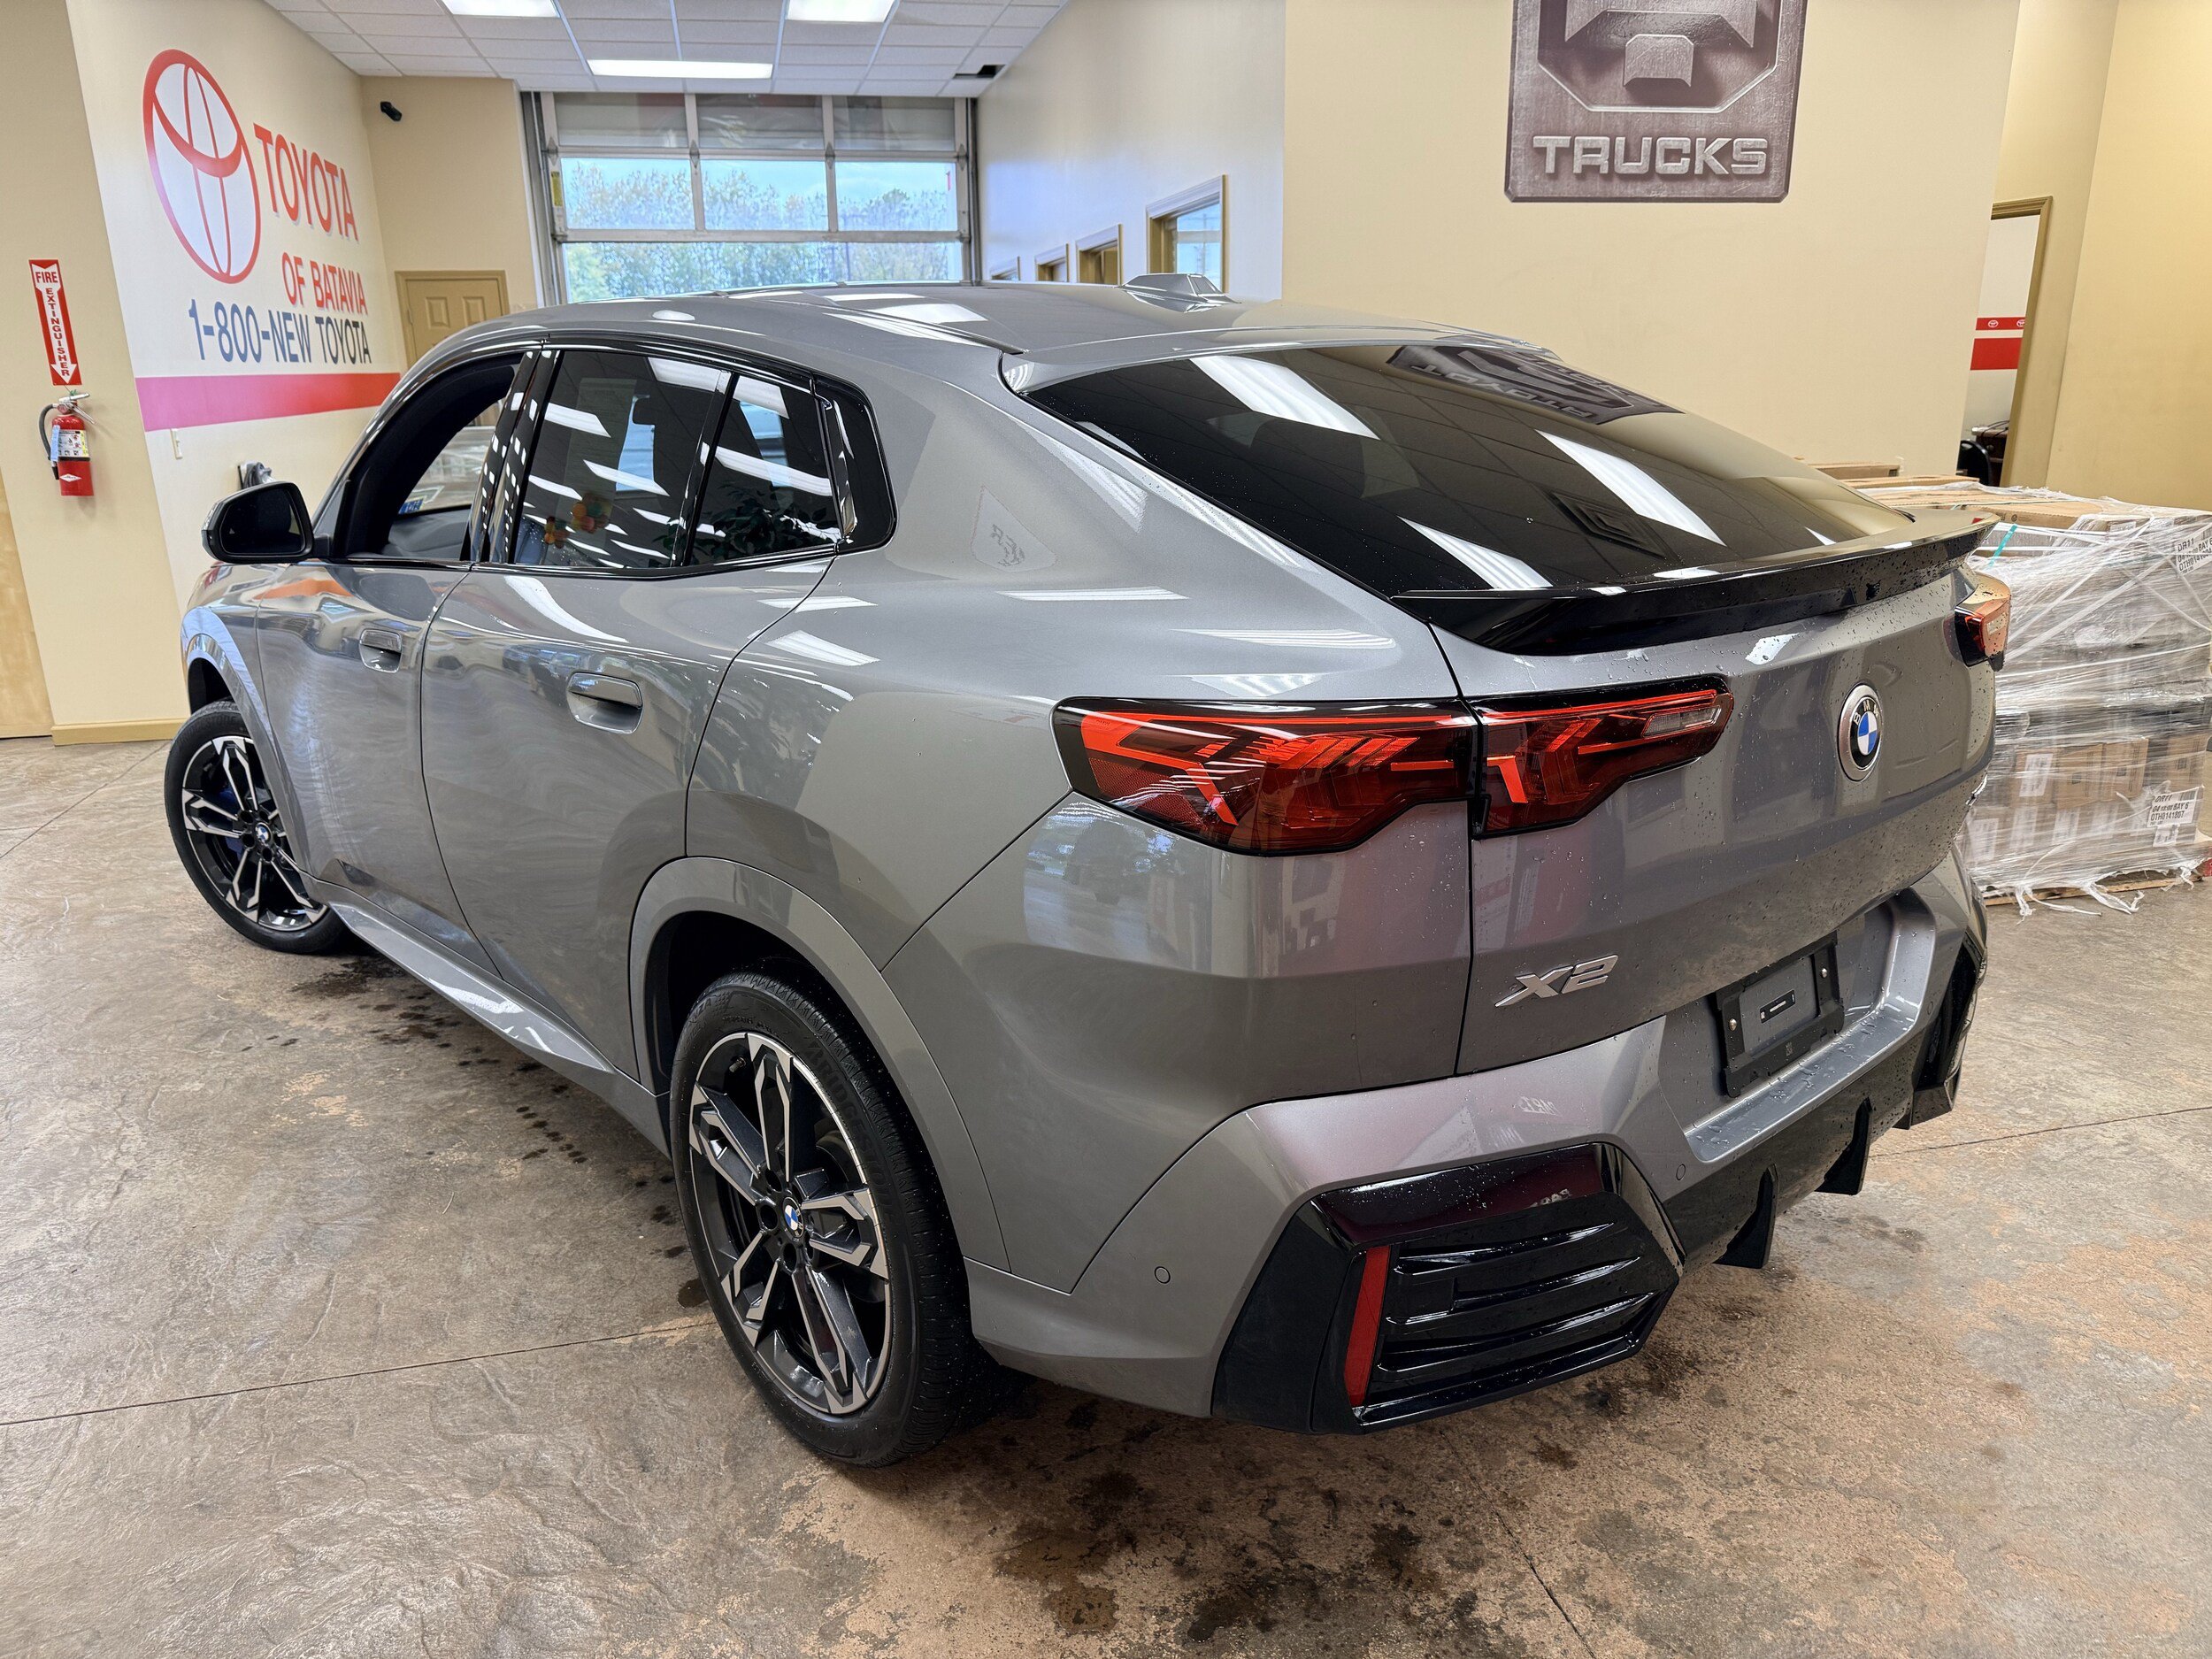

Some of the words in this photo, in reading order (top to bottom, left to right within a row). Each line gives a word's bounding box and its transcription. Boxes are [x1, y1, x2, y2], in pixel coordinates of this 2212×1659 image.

[253, 122, 359, 242] TOYOTA
[1532, 135, 1768, 175] TRUCKS
[35, 272, 58, 283] FIRE
[281, 252, 305, 306] OF
[310, 260, 368, 315] BATAVIA
[45, 288, 70, 376] EXTINGUISHER
[188, 299, 311, 363] 1-800-NEW
[315, 316, 372, 365] TOYOTA
[1494, 954, 1618, 1007] X2
